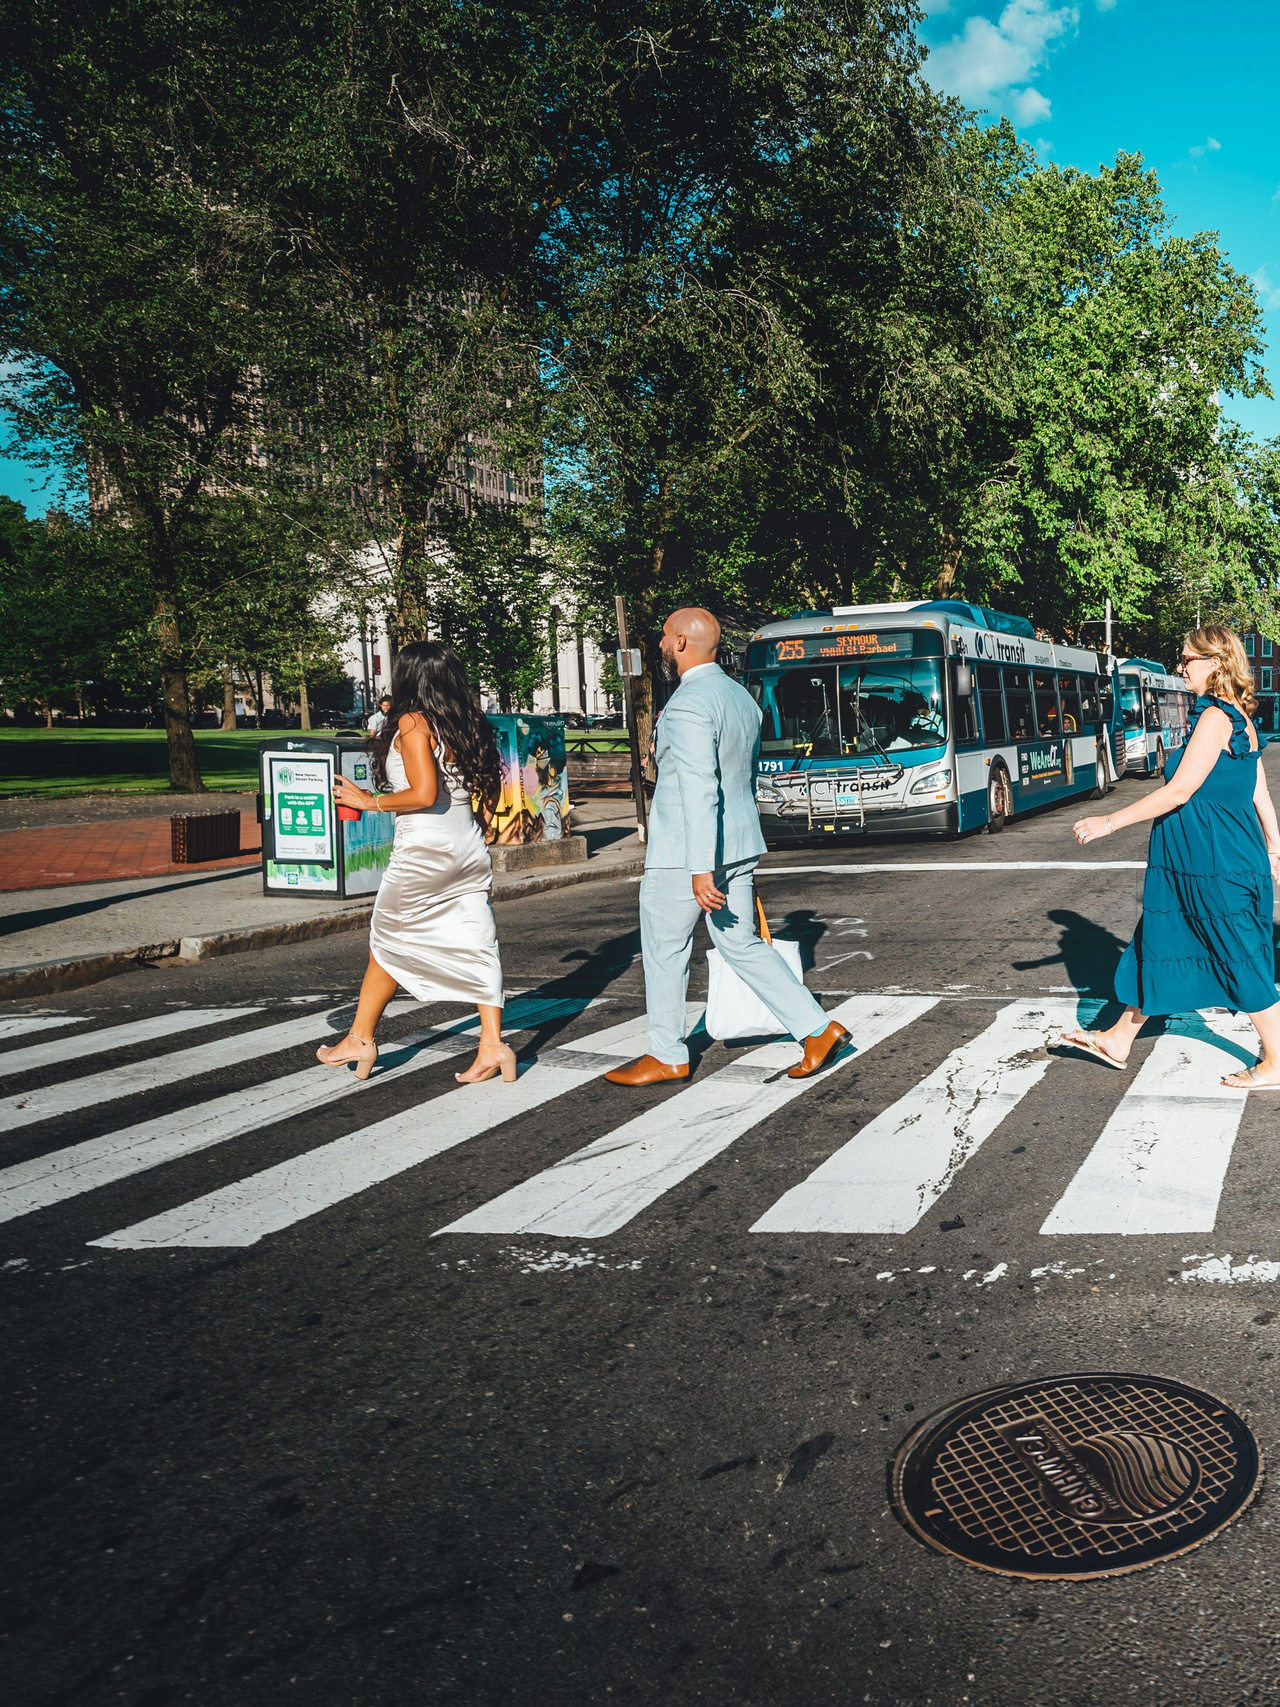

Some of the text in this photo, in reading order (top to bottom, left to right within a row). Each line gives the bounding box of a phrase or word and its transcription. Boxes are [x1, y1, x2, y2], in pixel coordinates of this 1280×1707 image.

[836, 633, 878, 647] SEYMOUR
[775, 639, 805, 661] 255
[846, 645, 858, 656] St
[278, 769, 293, 784] NHV
[1015, 1428, 1105, 1518] GNHWPCA
